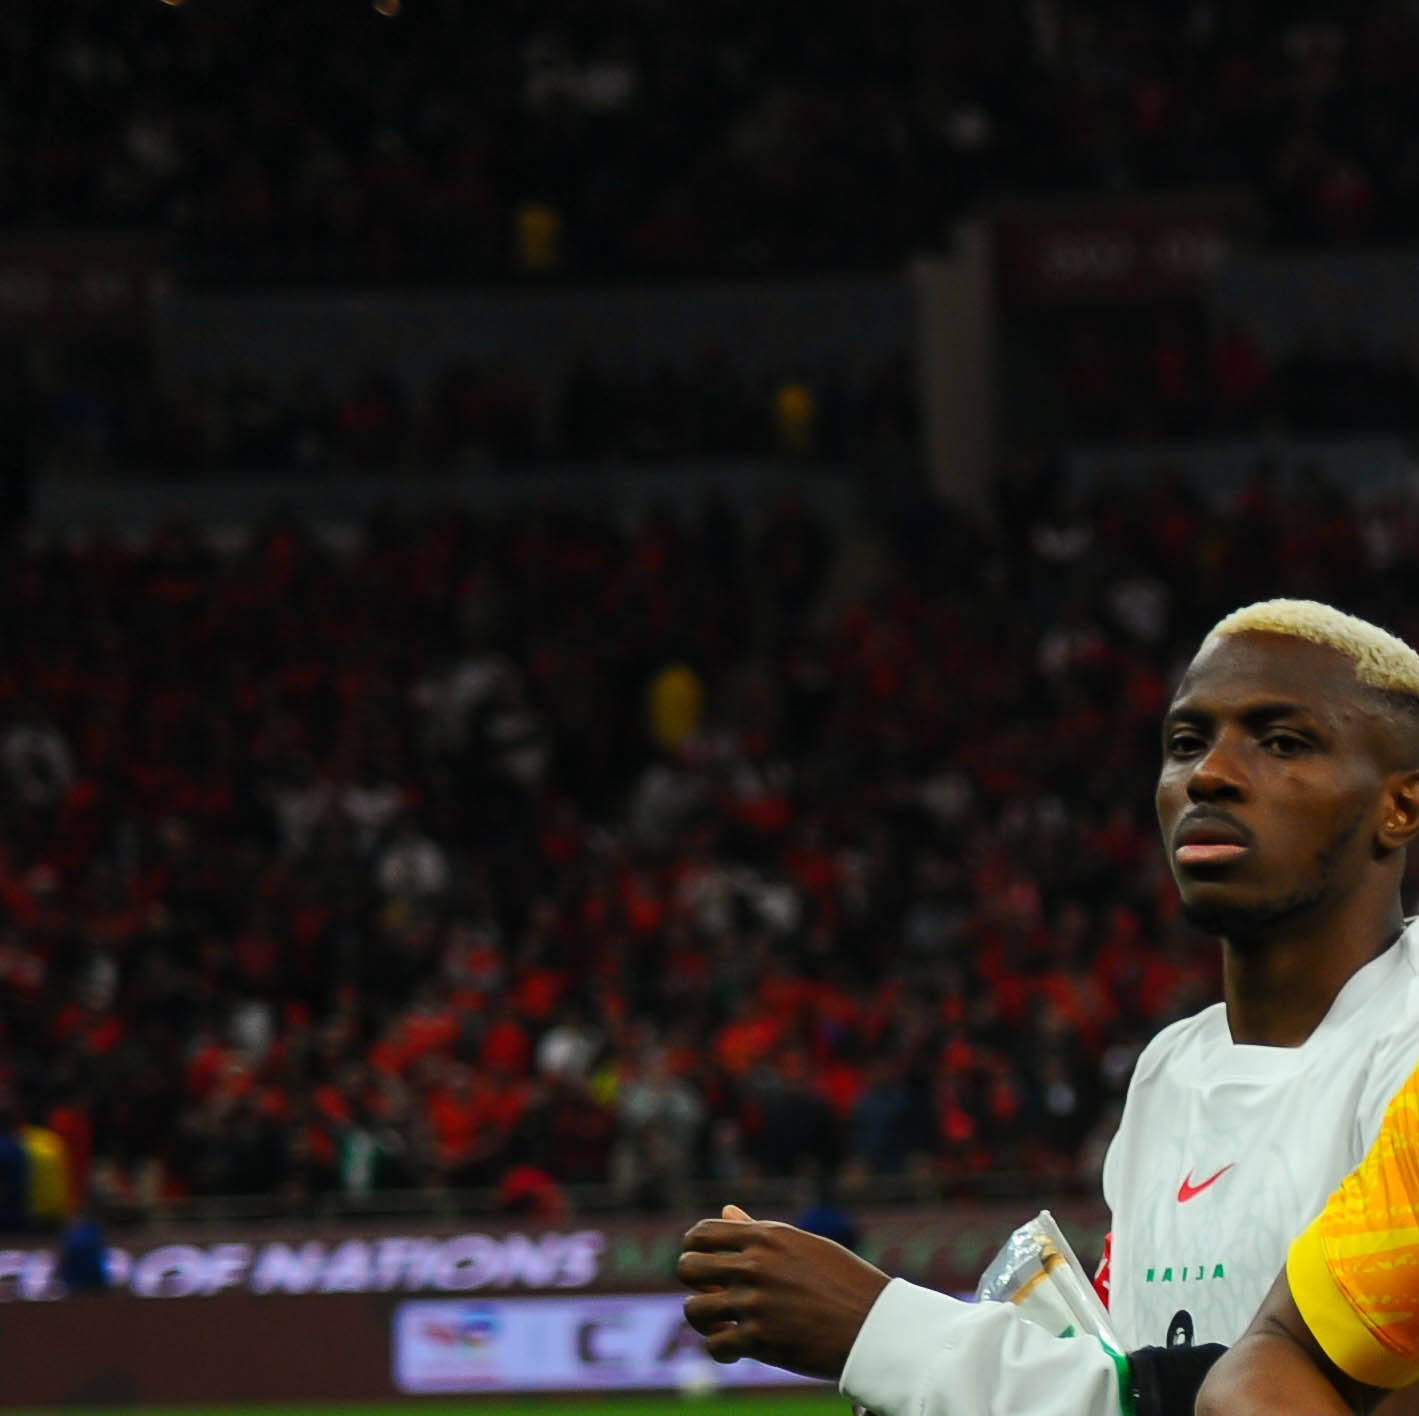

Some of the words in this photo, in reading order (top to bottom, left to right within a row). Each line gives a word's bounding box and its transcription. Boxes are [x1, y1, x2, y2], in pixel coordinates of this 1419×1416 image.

[132, 1242, 251, 1298] OF
[251, 1231, 602, 1294] NATIONS
[1146, 1263, 1225, 1283] NAIJA
